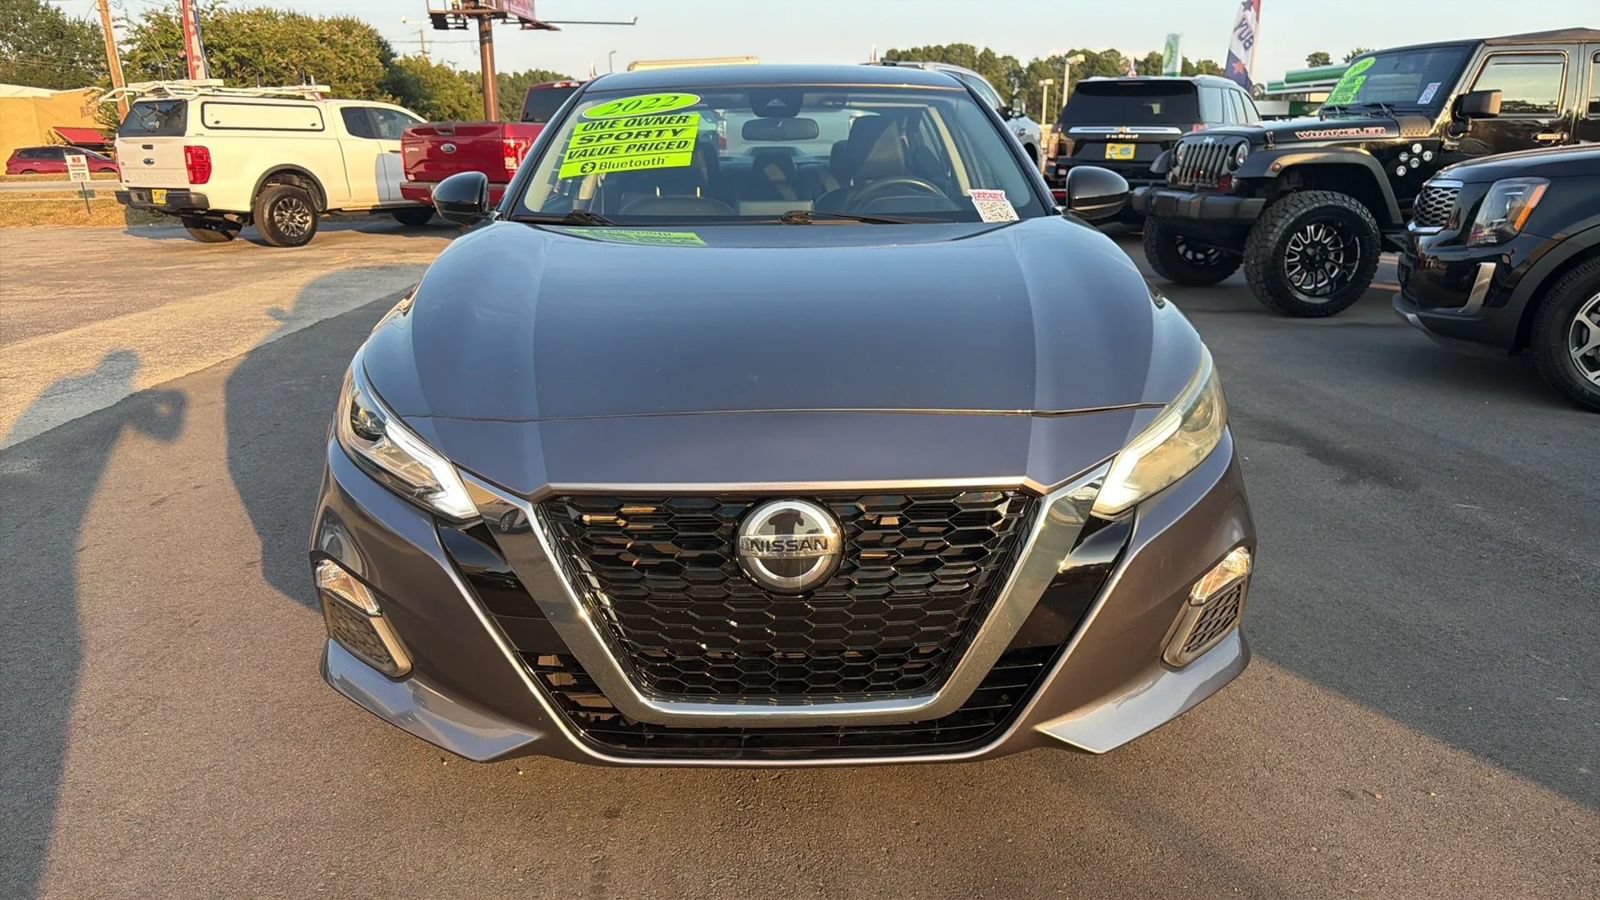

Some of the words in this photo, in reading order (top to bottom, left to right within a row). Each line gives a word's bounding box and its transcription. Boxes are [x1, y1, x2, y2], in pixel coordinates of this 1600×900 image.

[1233, 18, 1255, 51] BUY
[603, 96, 680, 115] 2022
[582, 119, 622, 132] ONE
[623, 115, 690, 128] OWNER
[577, 128, 687, 146] SPORTY
[568, 146, 622, 161] VALUE
[625, 140, 689, 153] PRICED
[599, 156, 666, 171] Bluetooth
[750, 538, 828, 552] NISSAN
